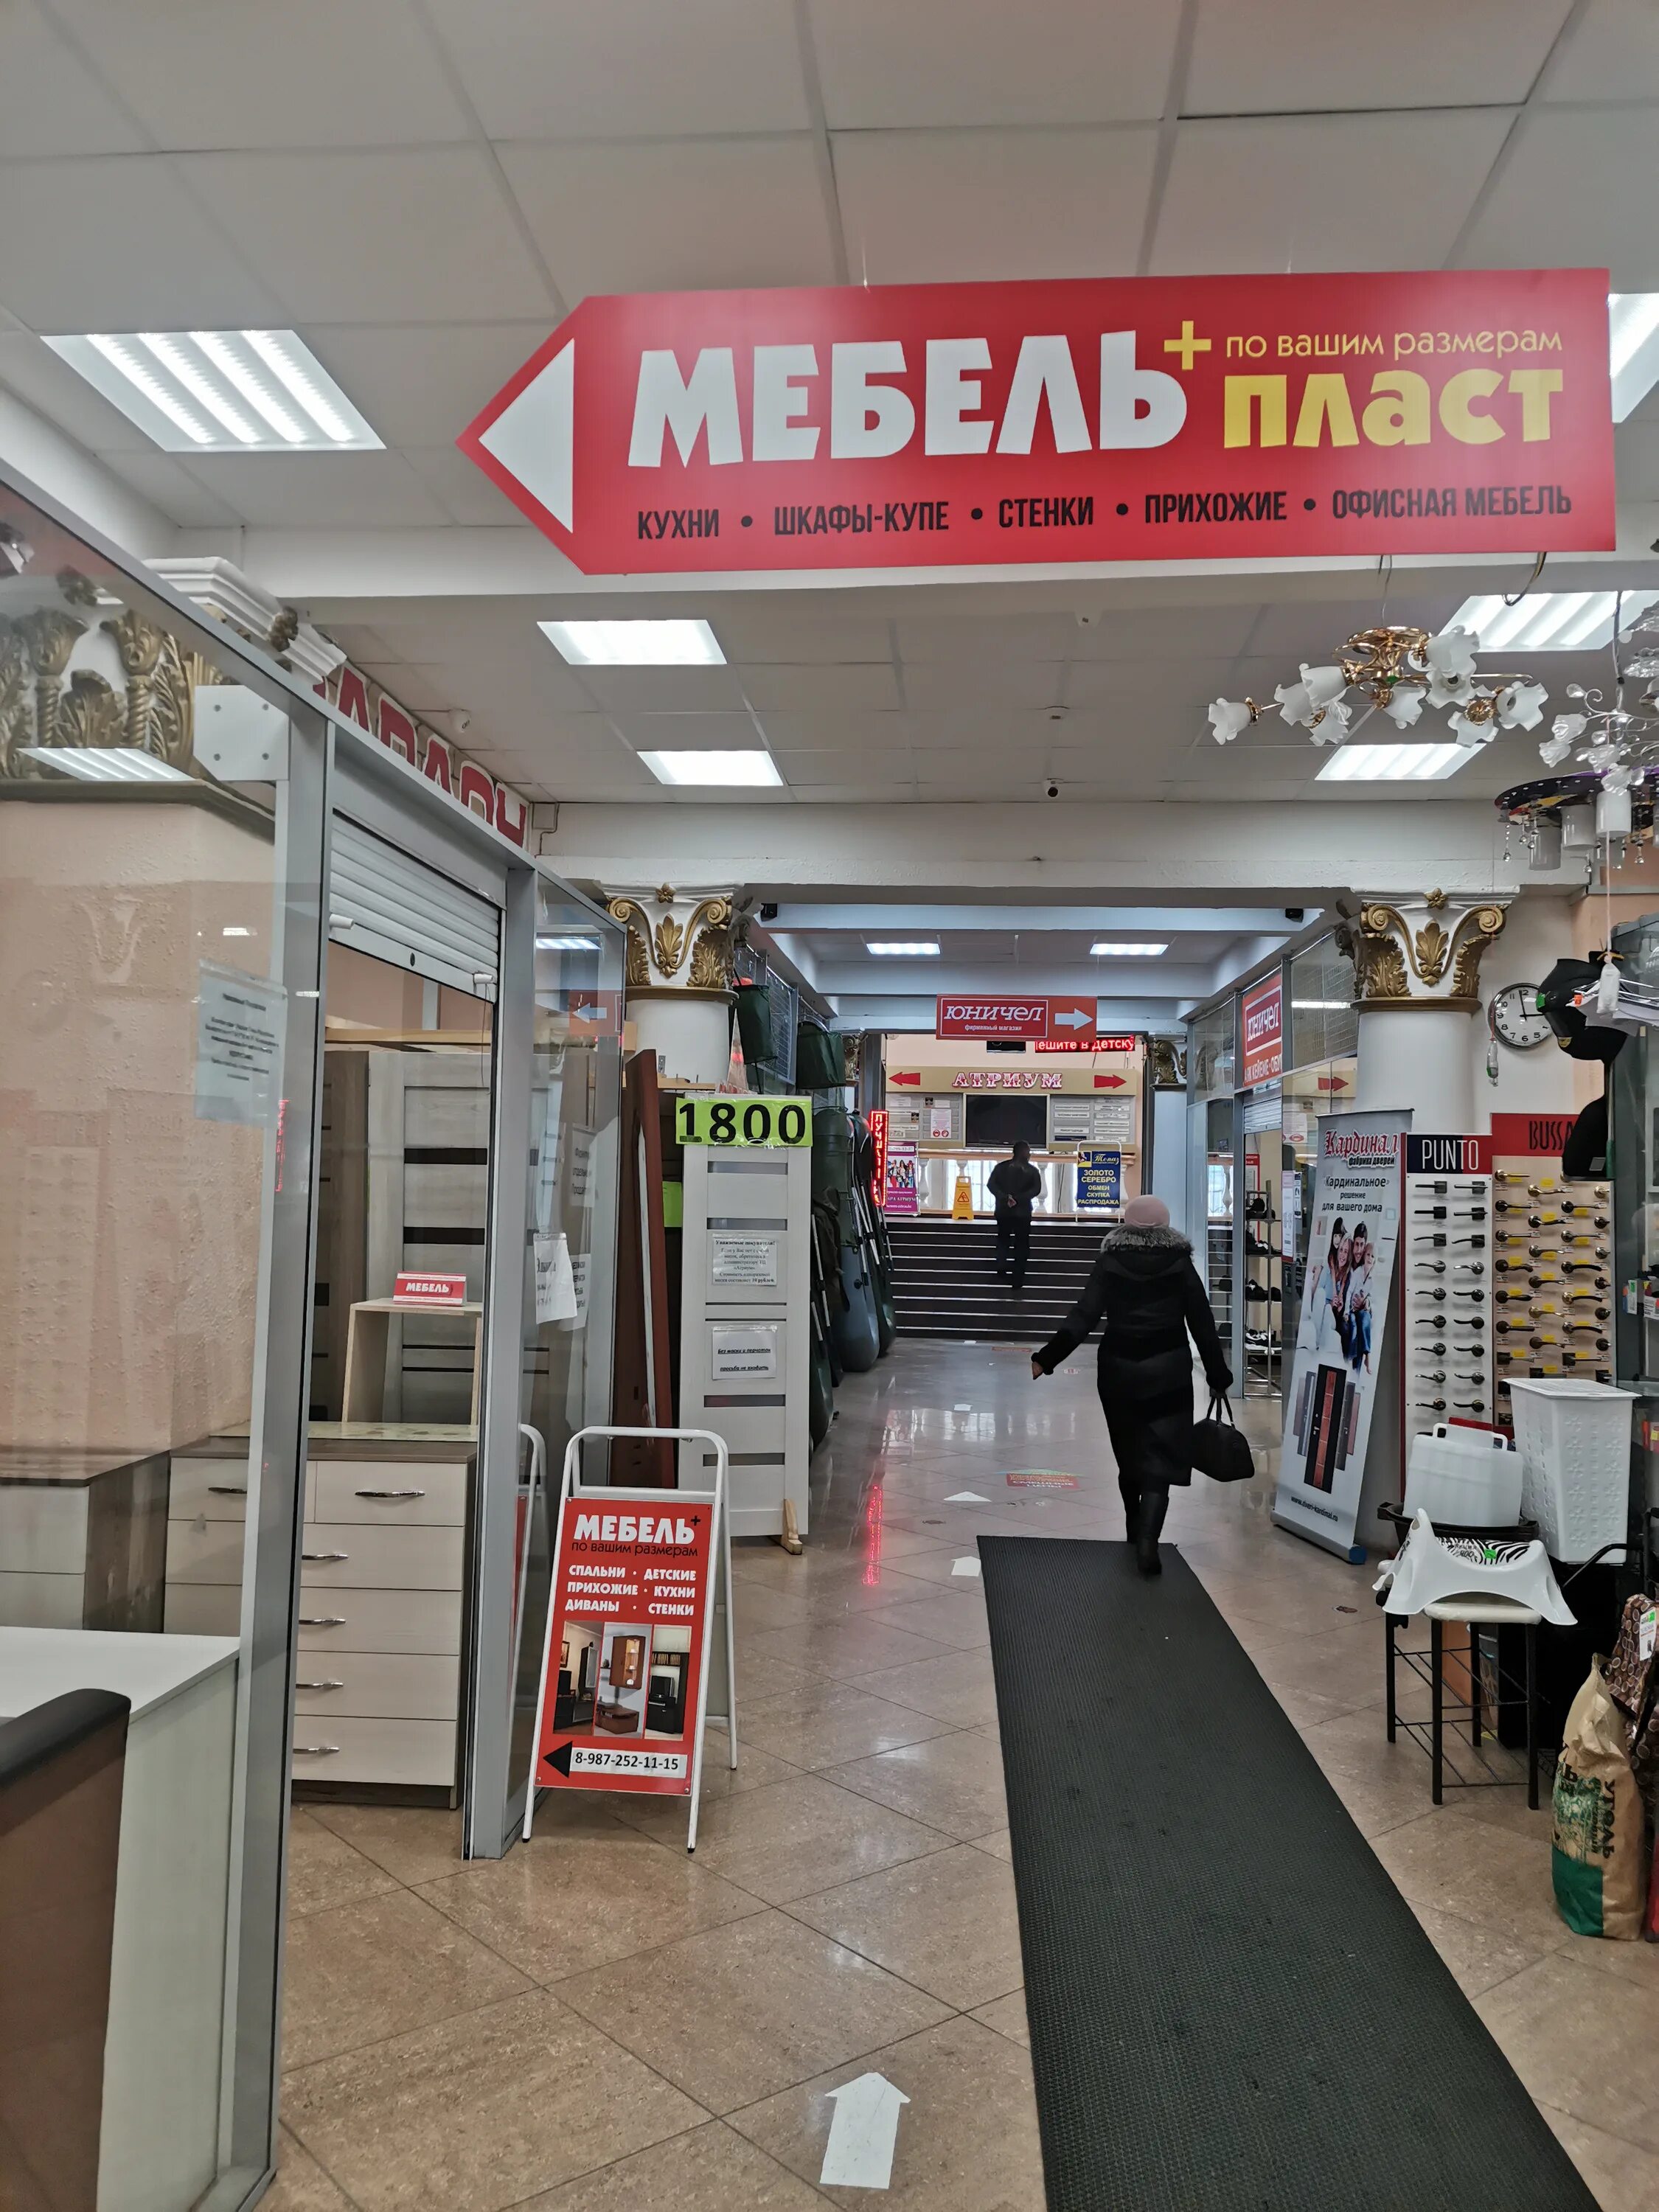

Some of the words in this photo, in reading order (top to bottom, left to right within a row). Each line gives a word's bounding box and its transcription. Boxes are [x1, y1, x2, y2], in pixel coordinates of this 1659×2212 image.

[1225, 335, 1267, 358] по
[1277, 333, 1385, 358] вашим
[1394, 329, 1562, 361] размерам
[637, 508, 720, 540] КУХНИ
[773, 501, 949, 536] ШКАФЫ-КУПЕ
[998, 496, 1094, 528] СТЕНКИ
[1145, 490, 1287, 524] ПРИХОЖИЕ
[1332, 487, 1458, 520] ОФИСНАЯ
[1465, 484, 1572, 517] МЕБЕЛЬ
[952, 1071, 1063, 1090] АТРИУМ
[678, 1102, 807, 1144] 1800
[1324, 1130, 1399, 1160] Кардинал
[1372, 1155, 1395, 1166] дверей
[1422, 1139, 1479, 1171] PUNTO
[1325, 1176, 1386, 1189] Кардинальное
[1340, 1192, 1366, 1200] решение
[1321, 1203, 1335, 1211] для
[1336, 1203, 1363, 1213] вашего
[1363, 1204, 1383, 1214] дома
[406, 1282, 450, 1293] МЕБЕЛЬ
[571, 1542, 588, 1551] по
[591, 1543, 631, 1554] вашим
[634, 1544, 698, 1559] размерам
[568, 1564, 626, 1578] СПАЛЬНИ
[644, 1568, 697, 1582] ДЕТСКИЕ
[567, 1581, 639, 1596] ПРИХОЖИЕ
[653, 1585, 695, 1599] КУХНИ
[565, 1599, 619, 1613] ДИВАНЫ
[647, 1603, 695, 1616] СТЕНКИ
[575, 1751, 679, 1770] 8-987-252-11-15
